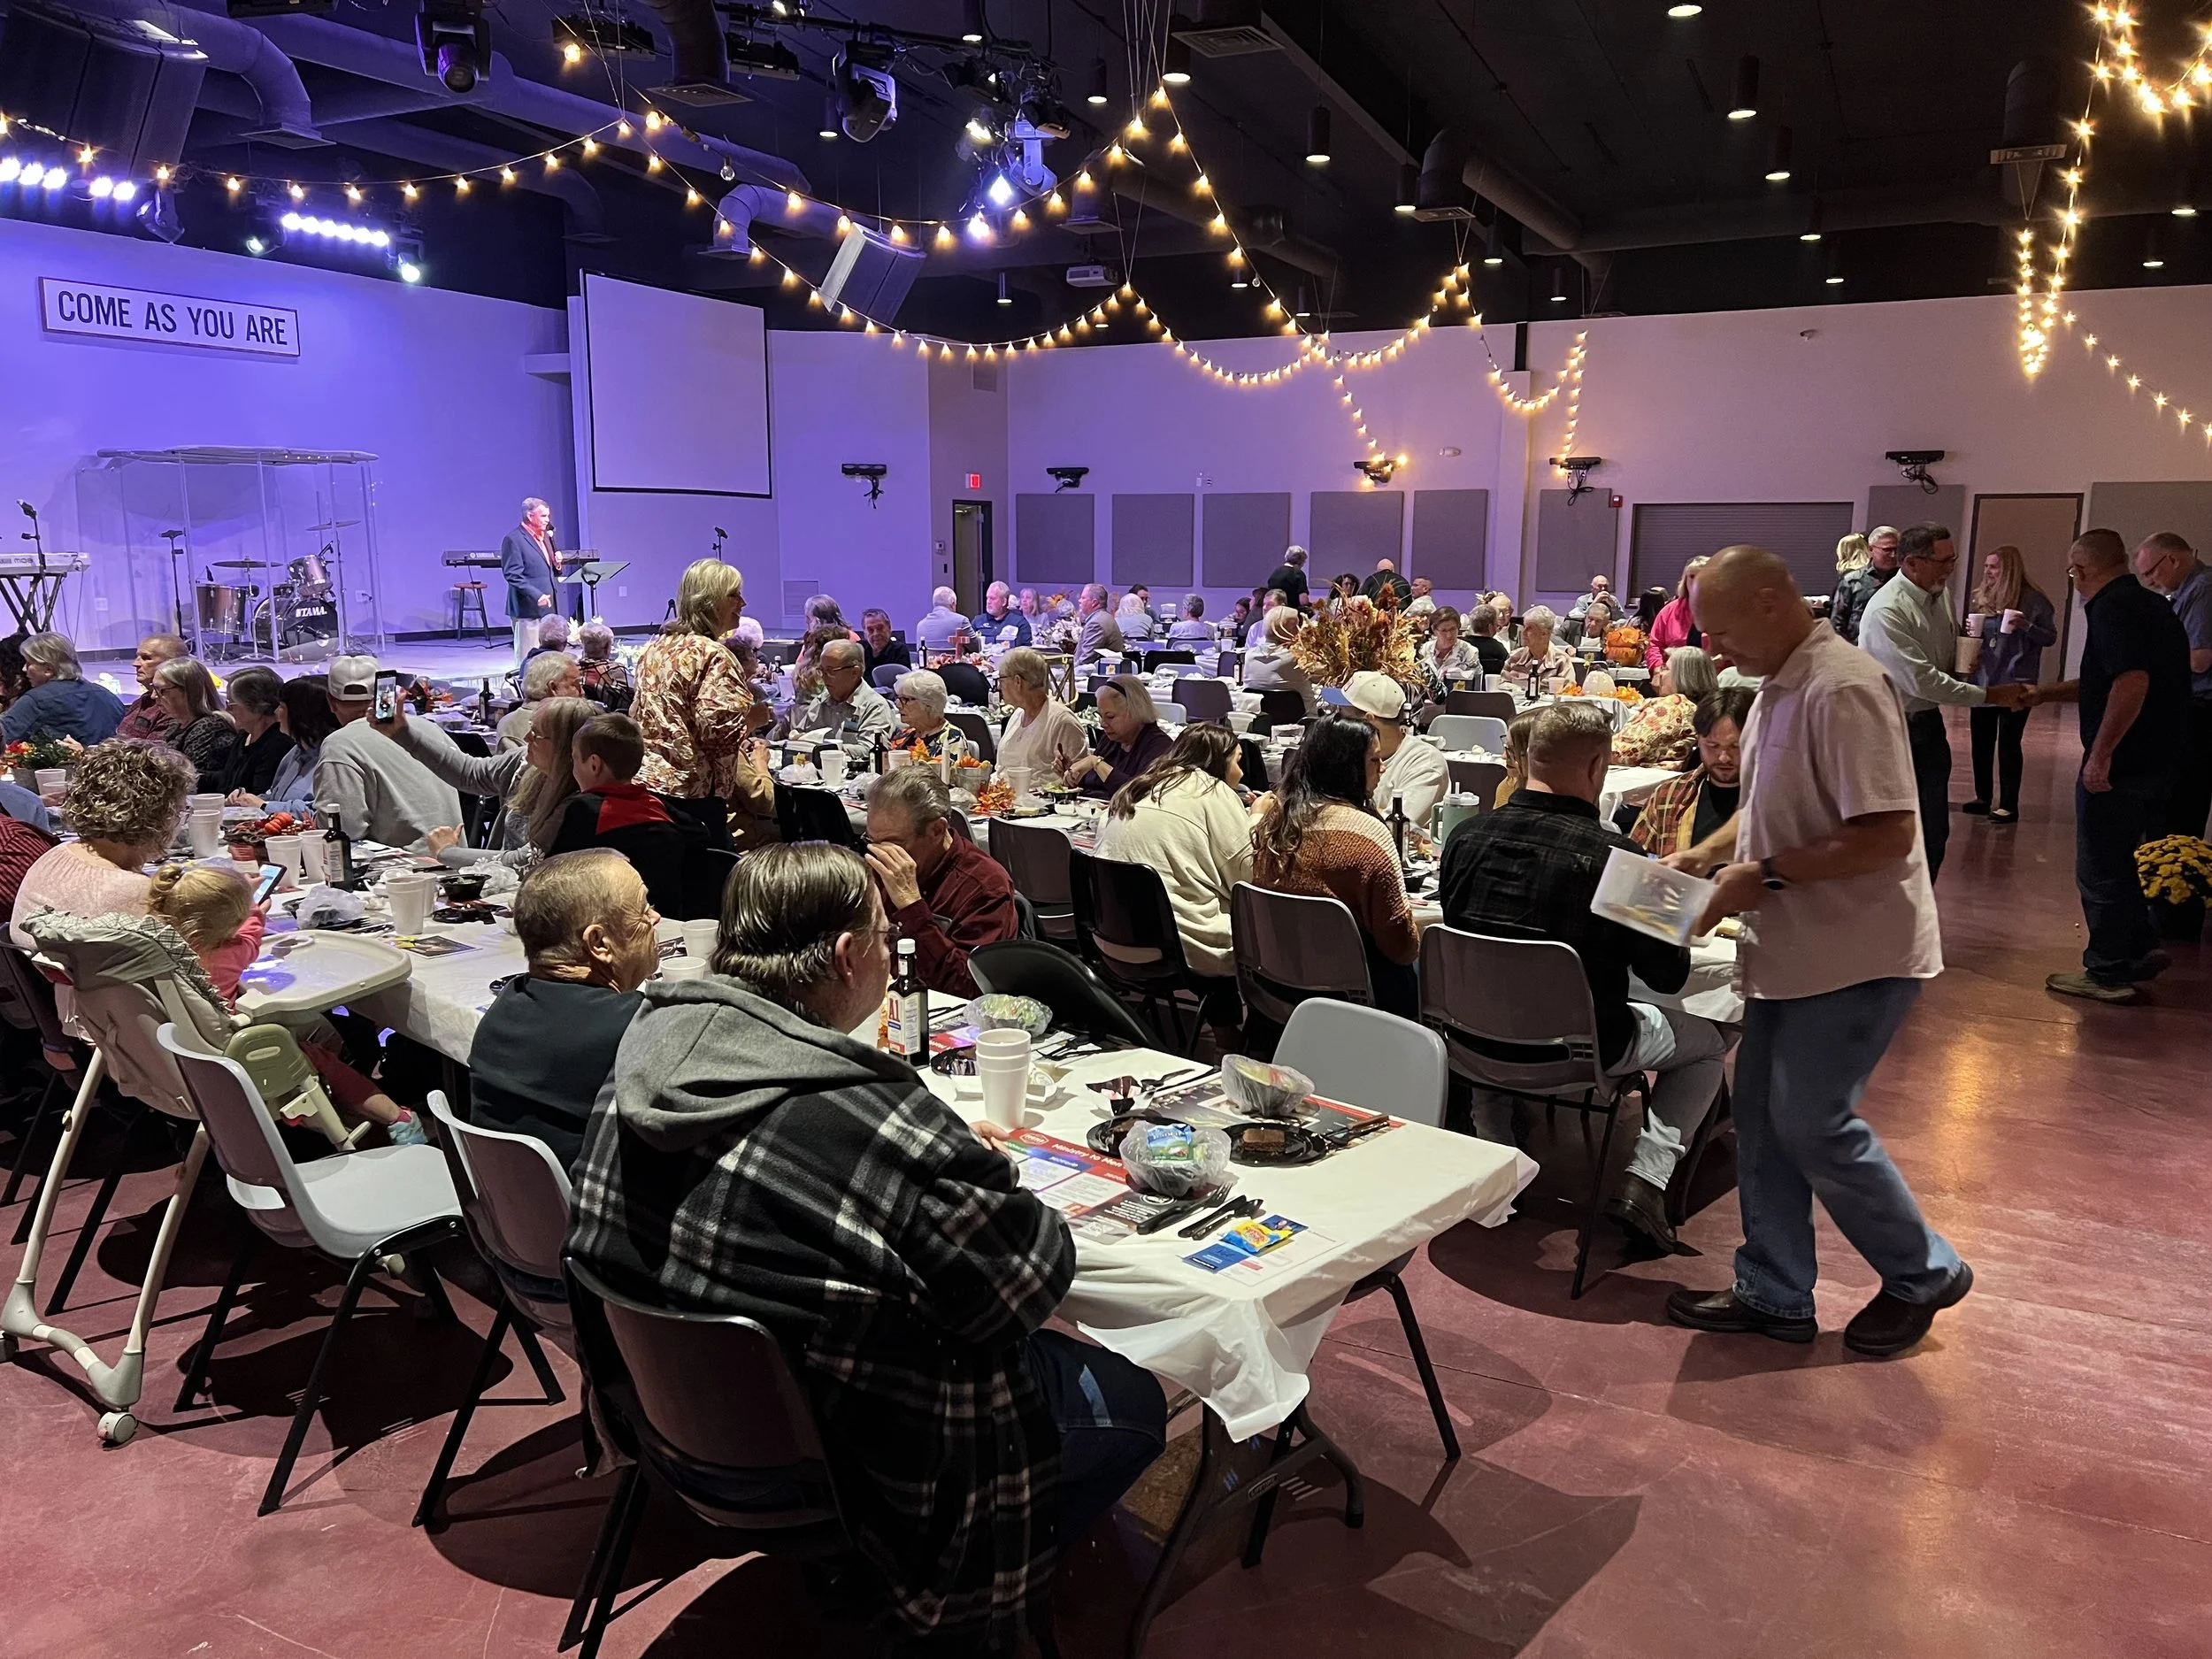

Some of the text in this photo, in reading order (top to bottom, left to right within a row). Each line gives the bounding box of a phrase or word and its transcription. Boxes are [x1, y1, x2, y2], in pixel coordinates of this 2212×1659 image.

[58, 290, 288, 346] COME AS YOU ARE
[1051, 1143, 1090, 1157] Ministry
[1101, 1157, 1123, 1167] Men
